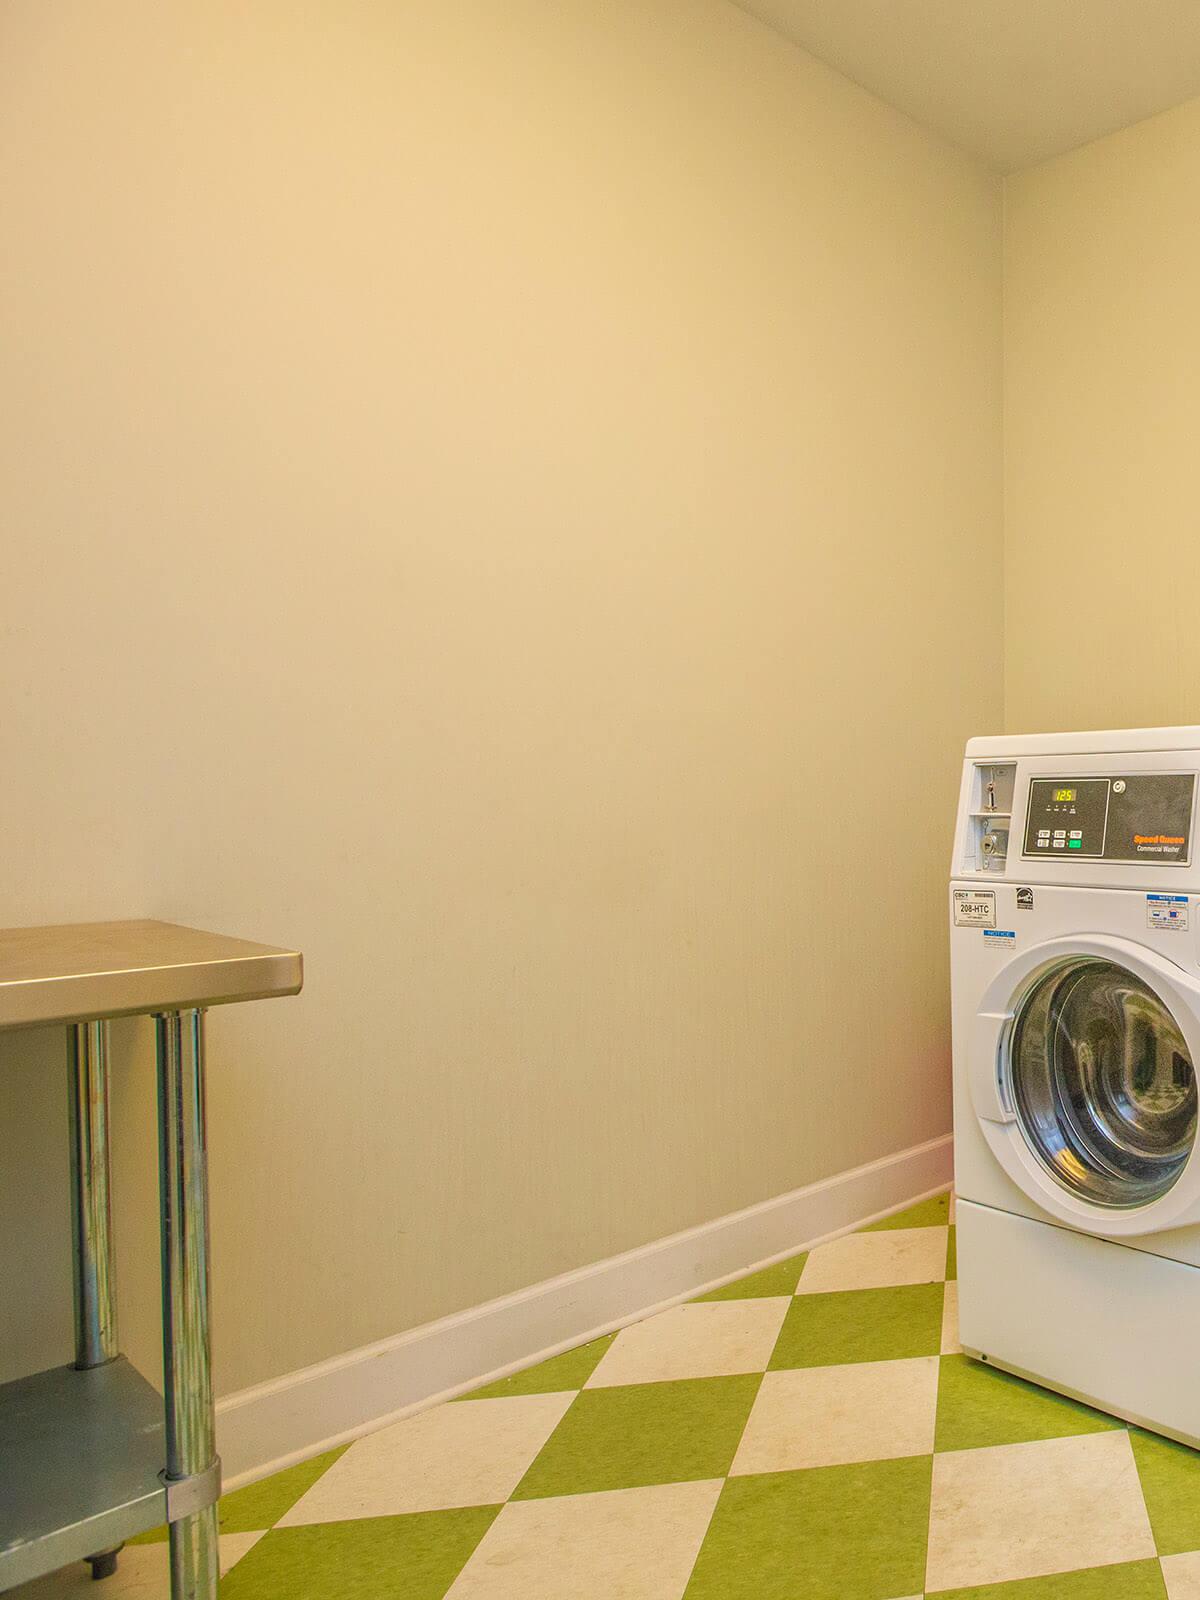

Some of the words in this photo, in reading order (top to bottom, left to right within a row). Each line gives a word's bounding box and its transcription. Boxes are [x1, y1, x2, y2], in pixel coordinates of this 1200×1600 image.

[1133, 835, 1159, 844] Speed
[1160, 835, 1185, 844] Queen
[960, 904, 989, 913] 208-HTC
